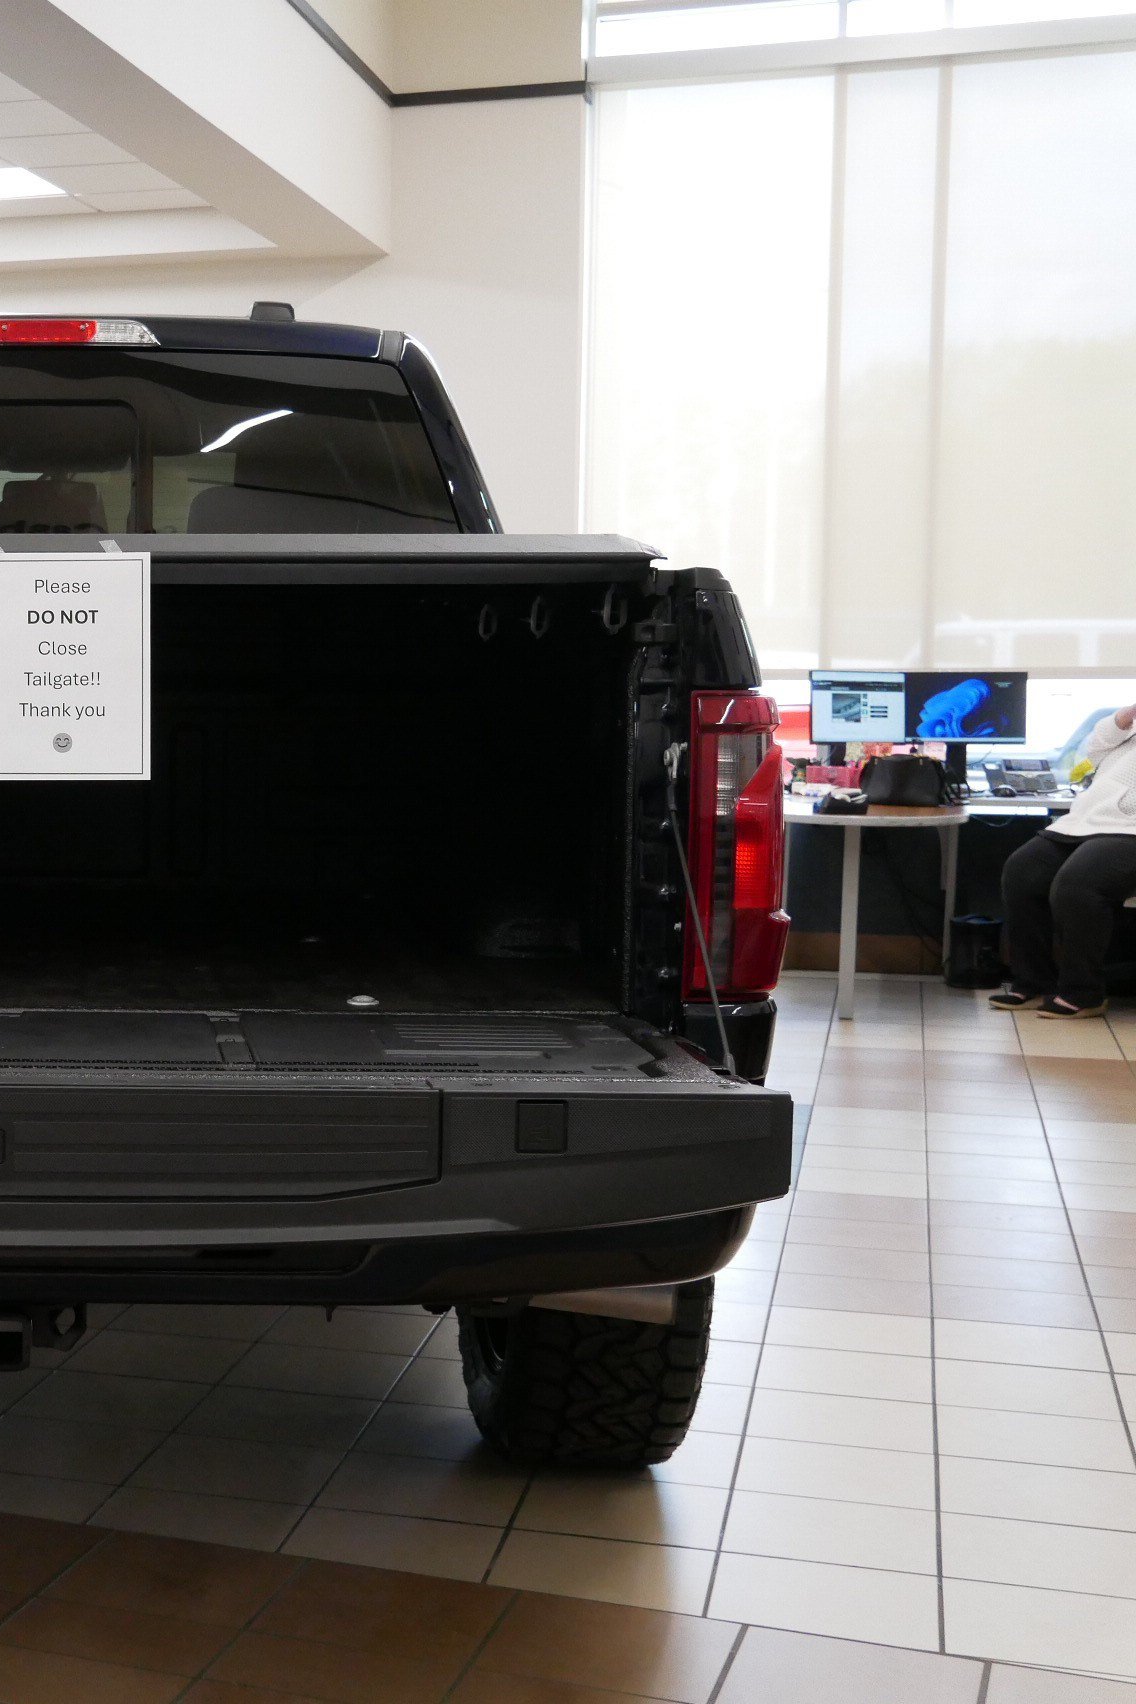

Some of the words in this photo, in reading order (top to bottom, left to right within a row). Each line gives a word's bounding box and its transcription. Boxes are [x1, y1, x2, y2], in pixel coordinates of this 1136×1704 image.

[34, 579, 91, 594] Please
[27, 609, 55, 625] DO
[60, 609, 99, 624] NOT
[38, 640, 87, 656] Close
[23, 671, 101, 690] Tailgate!!
[18, 702, 71, 717] Thank
[75, 704, 106, 721] you
